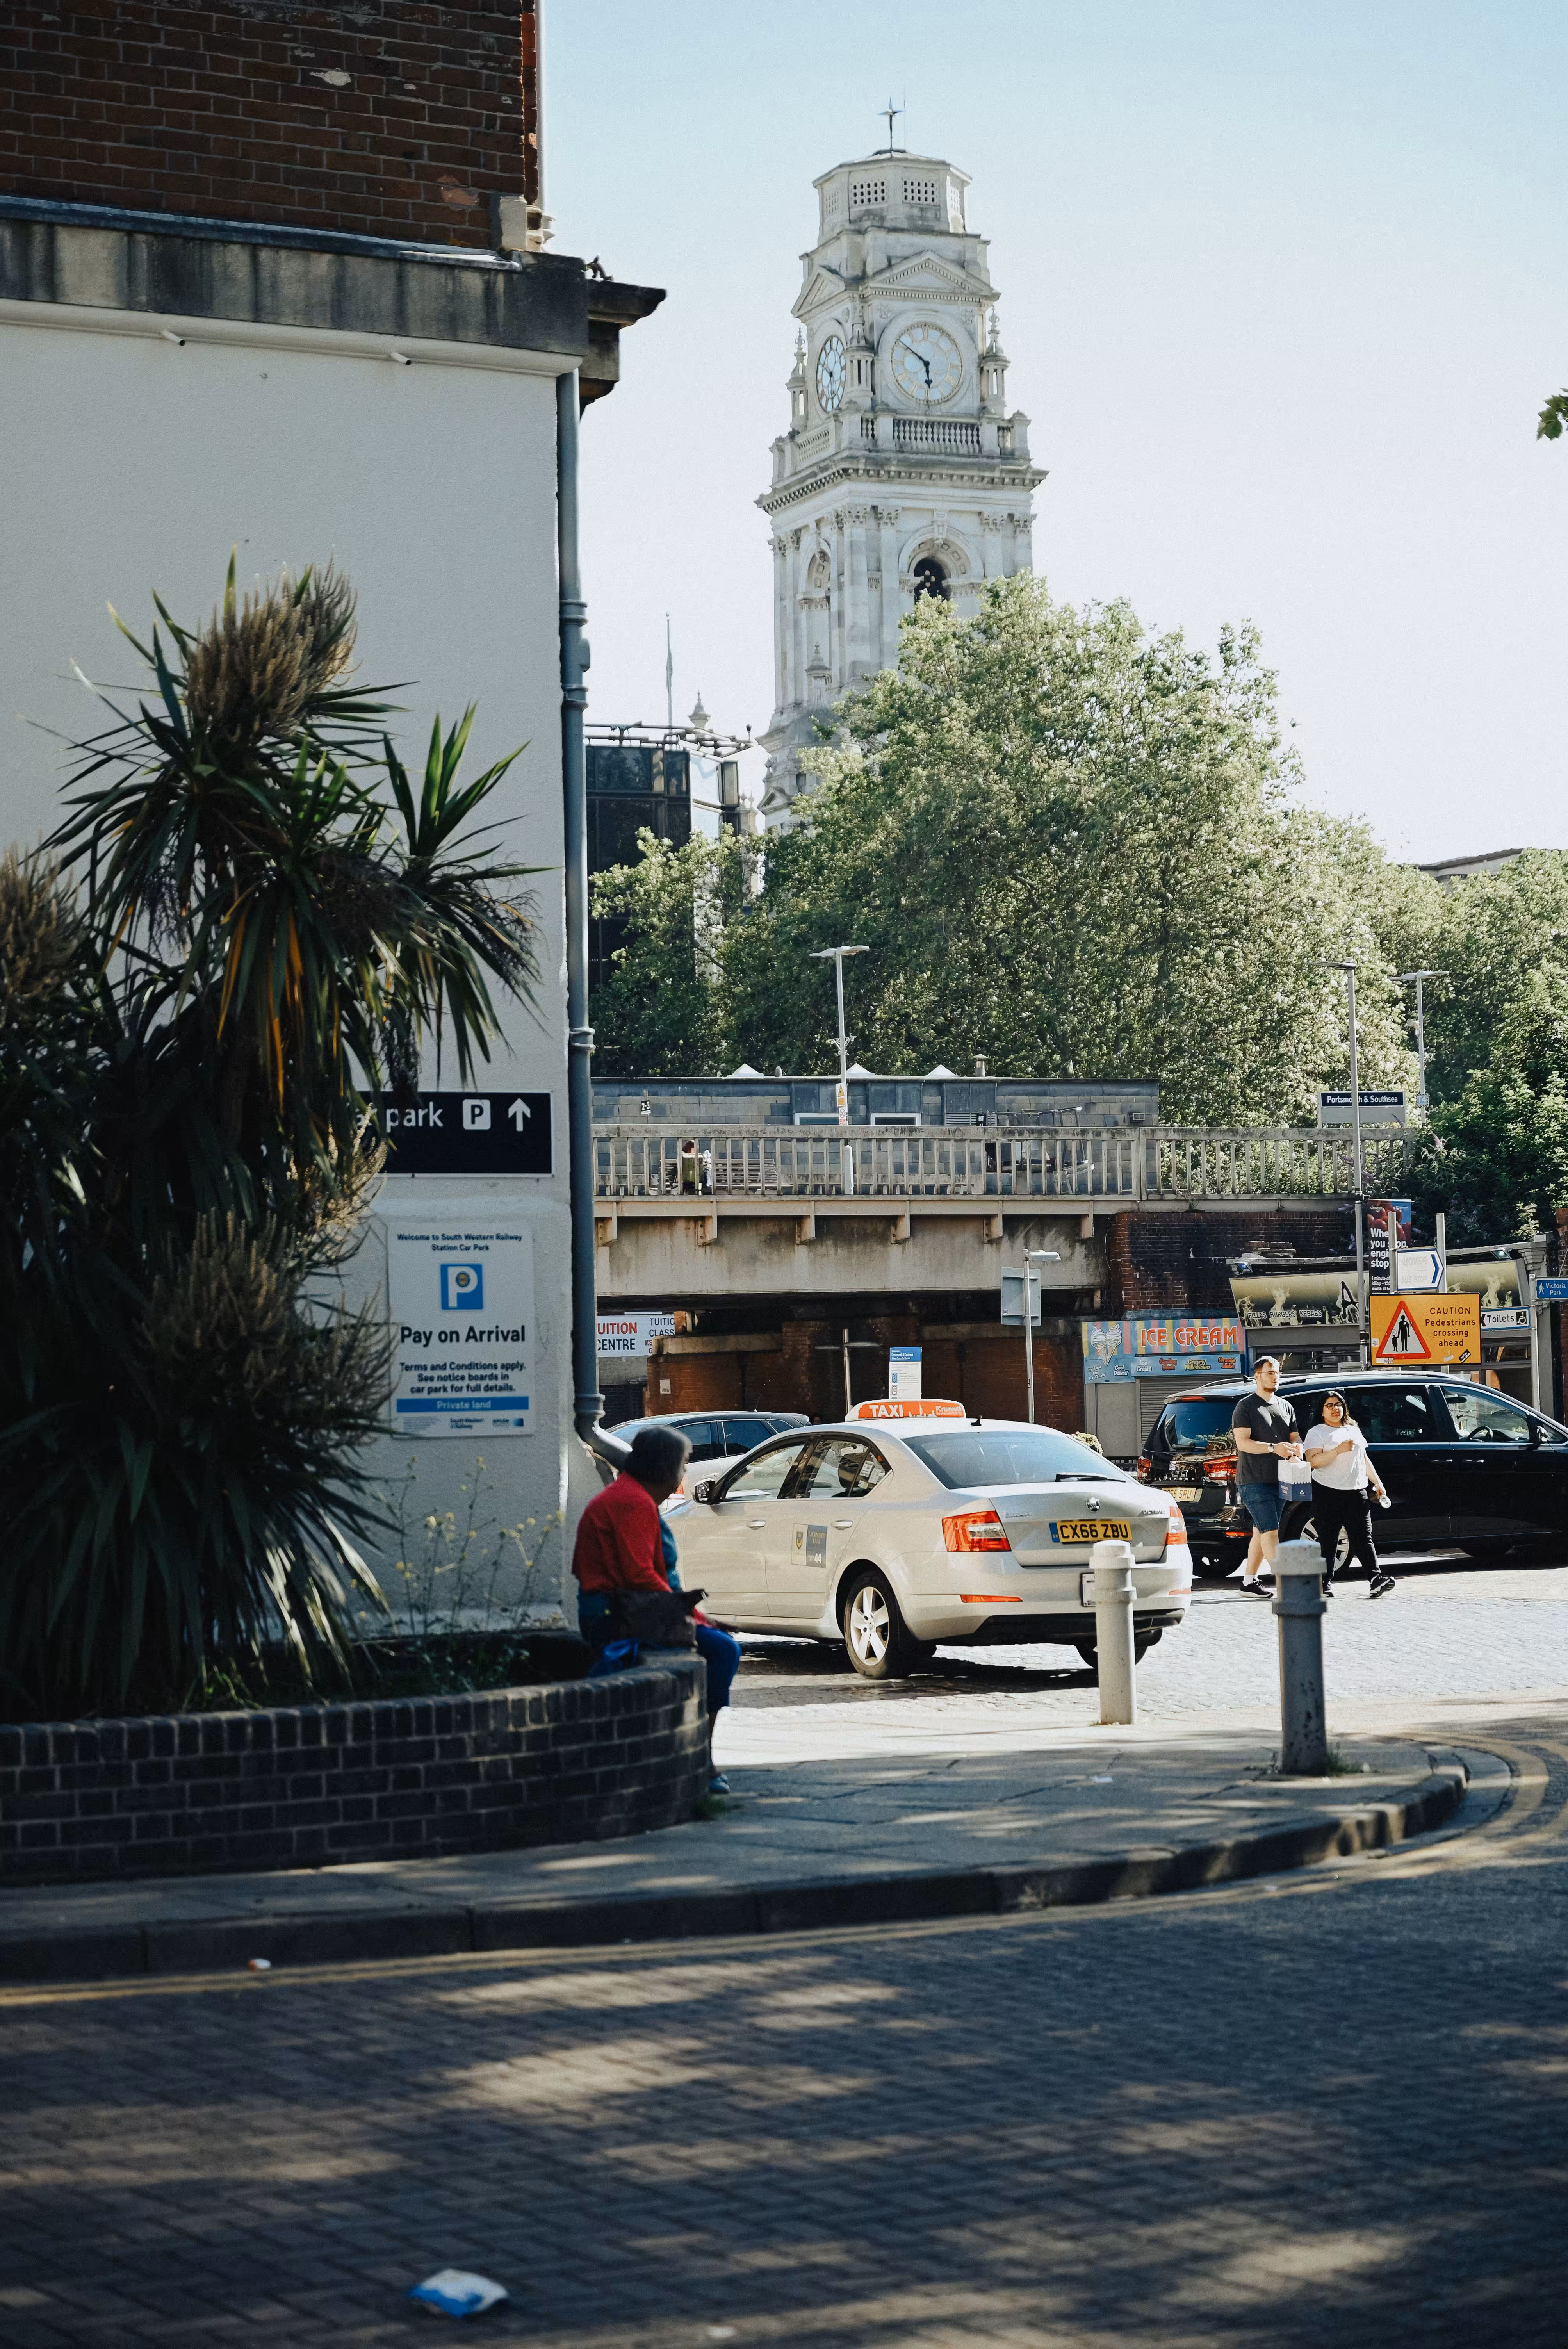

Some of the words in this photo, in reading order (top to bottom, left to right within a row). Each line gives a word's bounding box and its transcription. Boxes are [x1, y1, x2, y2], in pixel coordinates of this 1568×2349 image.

[641, 1101, 650, 1110] 2-3
[386, 1101, 444, 1132] park
[495, 1233, 522, 1242] Railway
[1370, 1228, 1390, 1238] Whe
[1370, 1240, 1385, 1249] you
[1388, 1240, 1408, 1249] op,
[1370, 1249, 1390, 1259] engi
[1299, 1309, 1322, 1318] KEBABS
[1487, 1314, 1514, 1323] Toilets
[650, 1318, 675, 1326] TUITIO
[1425, 1318, 1475, 1326] Pedestrians
[598, 1322, 638, 1335] UITION
[1433, 1328, 1468, 1337] crossing
[401, 1326, 433, 1347] Pay
[438, 1330, 460, 1342] on
[465, 1325, 526, 1342] Arrival
[1141, 1328, 1168, 1347] ICE
[1174, 1326, 1238, 1348] CREAM
[400, 1362, 428, 1371] Terms
[430, 1362, 447, 1371] and
[449, 1361, 498, 1371] Conditions
[500, 1361, 526, 1371] apply.
[417, 1373, 434, 1382] See
[437, 1373, 466, 1381] notice
[468, 1372, 498, 1381] boards
[501, 1372, 509, 1380] in
[428, 1385, 448, 1395] park
[467, 1383, 481, 1392] full
[483, 1383, 516, 1392] details.
[437, 1400, 470, 1409] Private
[472, 1400, 492, 1408] land
[870, 1404, 903, 1418] TAXI
[1179, 1490, 1192, 1499] SRU
[1060, 1524, 1099, 1539] CX66
[1101, 1524, 1128, 1538] ZBU
[814, 1553, 822, 1563] 44
